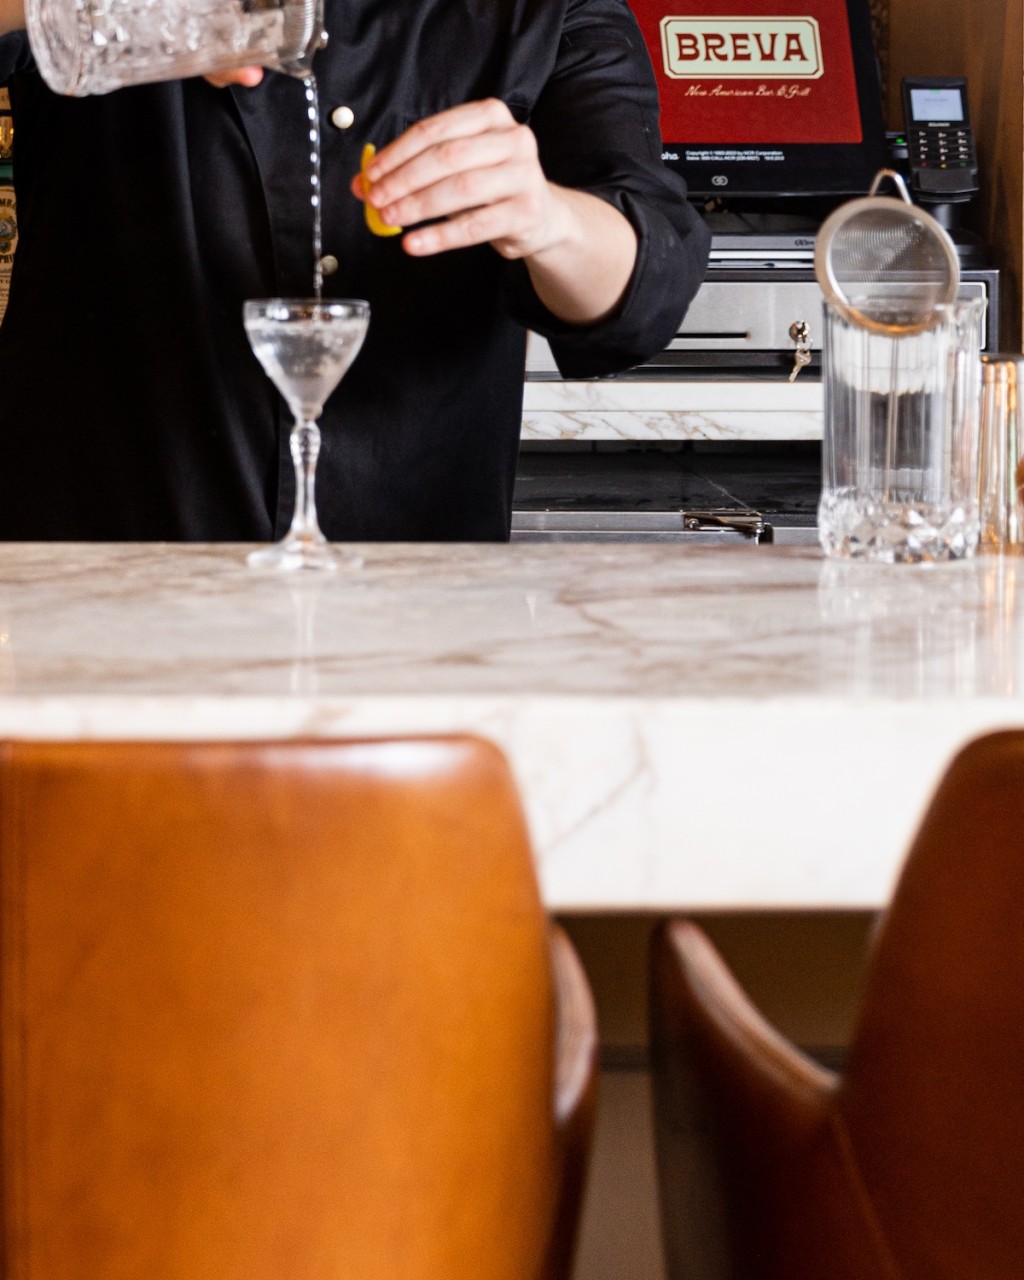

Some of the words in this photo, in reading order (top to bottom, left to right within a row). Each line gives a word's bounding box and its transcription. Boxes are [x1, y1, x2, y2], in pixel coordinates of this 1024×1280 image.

[675, 32, 809, 62] BREVA
[685, 84, 708, 97] New
[708, 84, 754, 97] American
[756, 84, 775, 97] Bar
[784, 85, 811, 100] Grill
